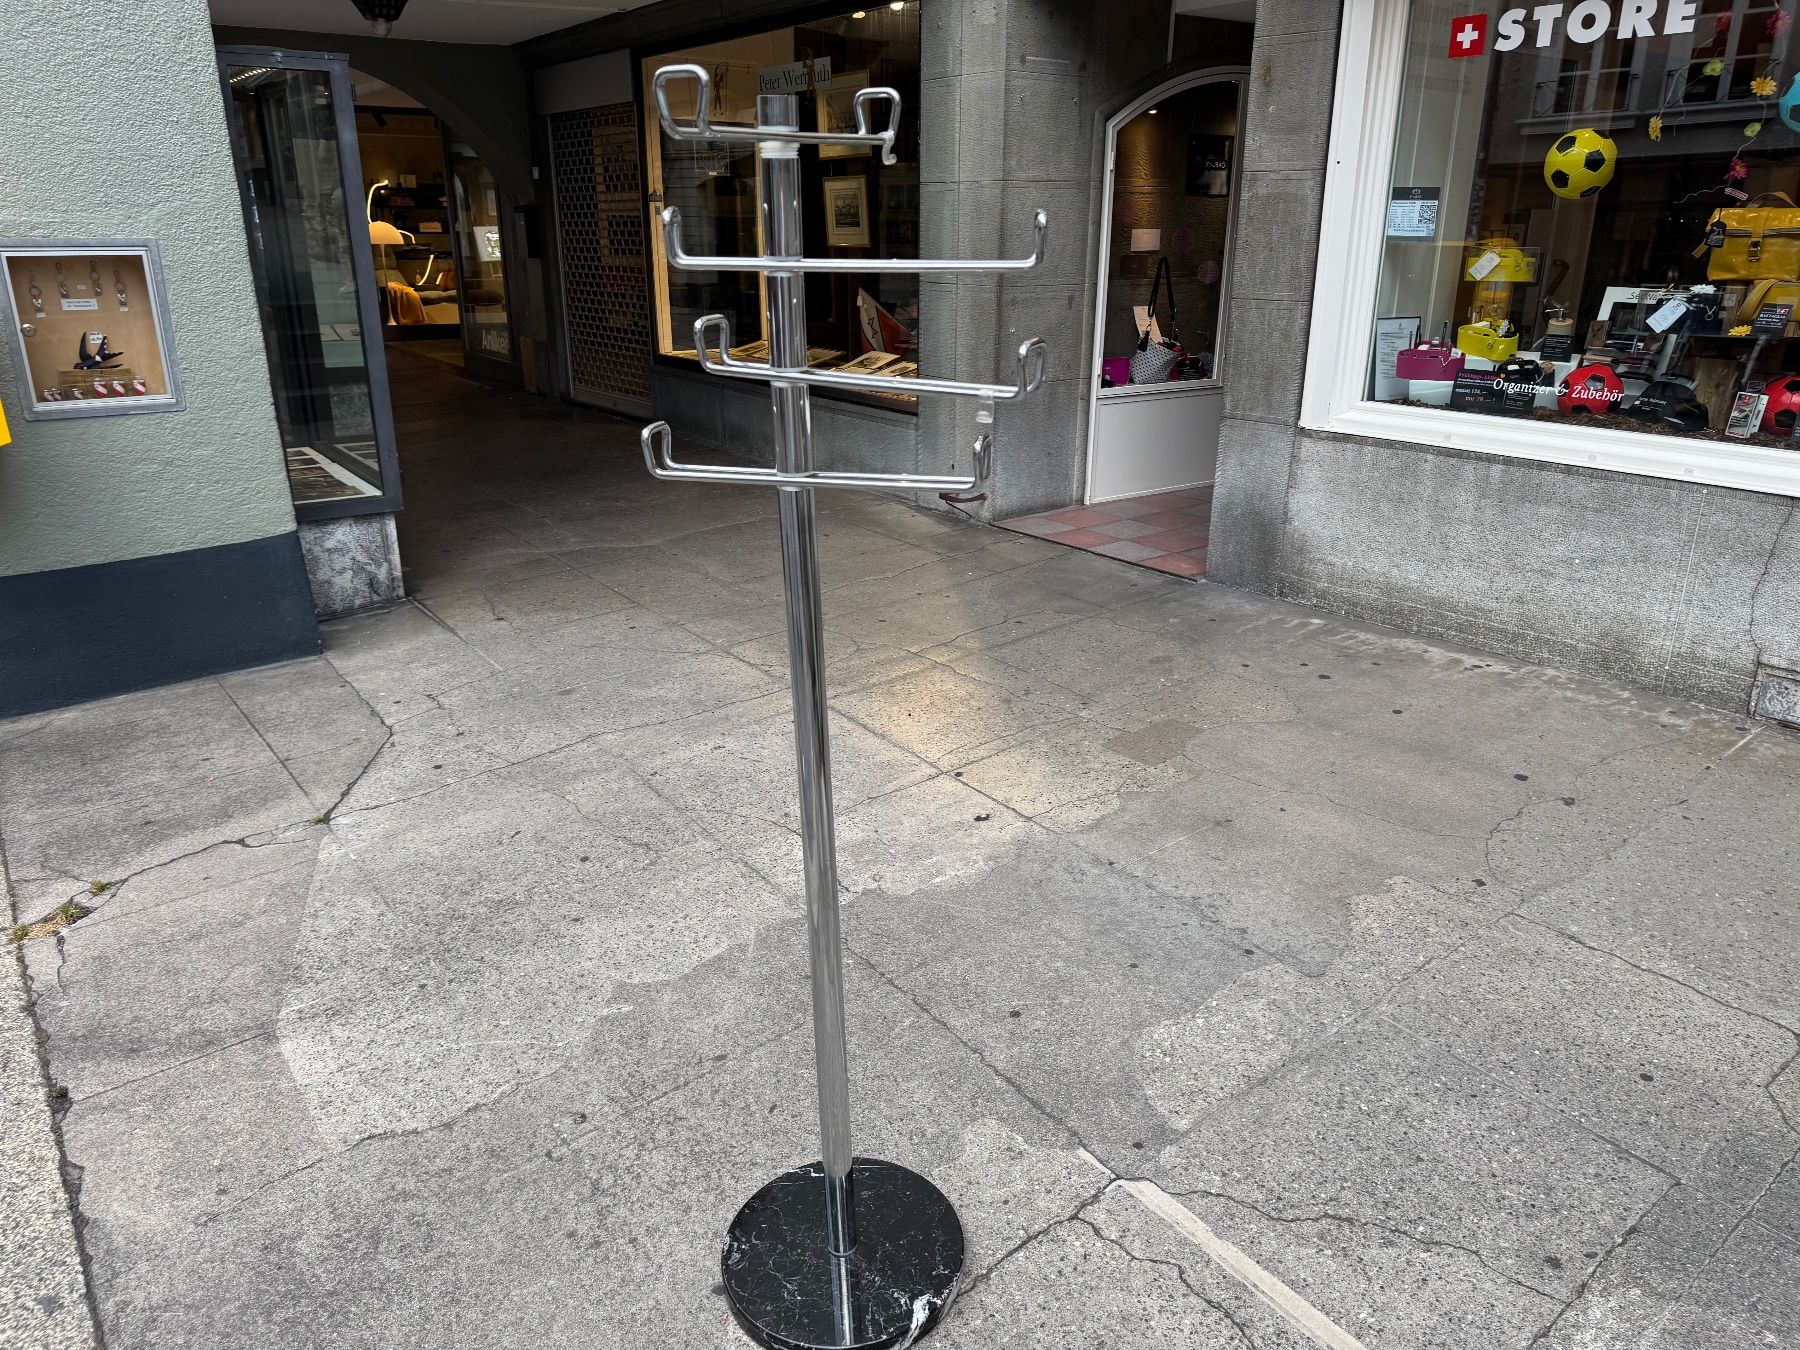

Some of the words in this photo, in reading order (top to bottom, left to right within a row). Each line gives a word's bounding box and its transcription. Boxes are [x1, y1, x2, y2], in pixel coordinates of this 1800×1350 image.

[1494, 0, 1697, 52] STORE
[759, 75, 781, 92] Peter
[1493, 378, 1553, 395] Organizer
[1555, 384, 1569, 396] &
[1571, 385, 1625, 402] Zubehör
